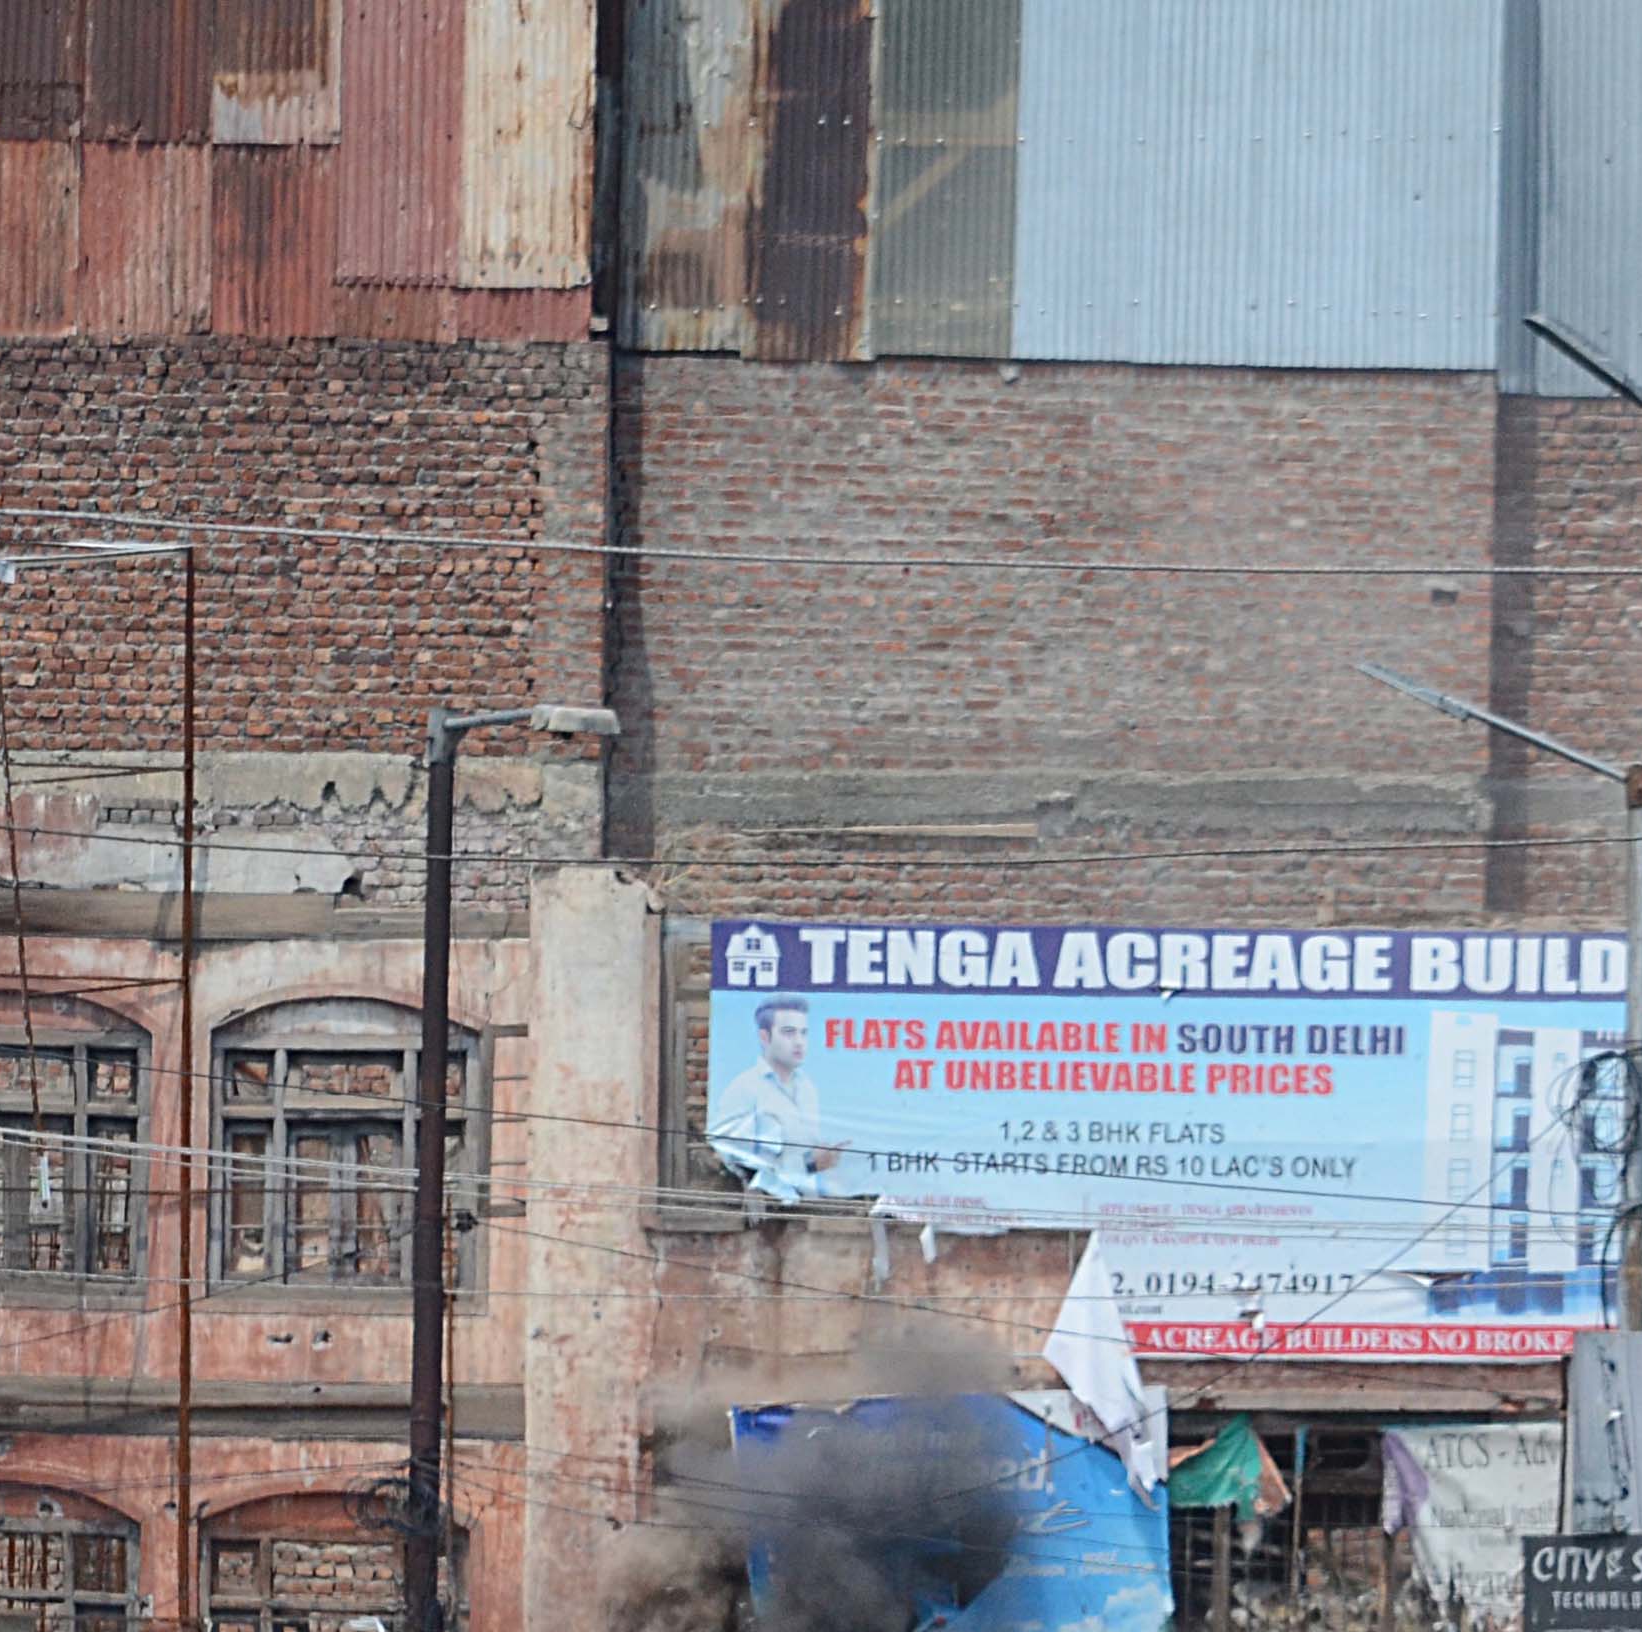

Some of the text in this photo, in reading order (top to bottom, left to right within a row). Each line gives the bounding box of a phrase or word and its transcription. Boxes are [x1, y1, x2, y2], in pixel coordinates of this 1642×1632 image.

[800, 929, 1041, 988] TENGA
[1053, 931, 1394, 993] ACREAGE
[825, 1018, 1407, 1056] FLATS AVAILABLE IN SOUTH DELHI
[894, 1059, 1334, 1096] AT UNBELIEVABLE PRICES
[1043, 1121, 1058, 1143] &
[1065, 1121, 1080, 1143] 3
[1088, 1121, 1140, 1144] BHK
[1149, 1122, 1226, 1145] FLATS
[886, 1152, 940, 1173] BHK
[953, 1151, 1049, 1174] STARTS
[1056, 1153, 1129, 1175] FROM
[1136, 1153, 1168, 1176] RS
[1177, 1156, 1205, 1177] 10
[1210, 1155, 1285, 1178] LAC'S
[1290, 1156, 1356, 1179] ONLY
[1147, 1328, 1284, 1350] ACREAGE
[1285, 1327, 1423, 1352] BUILDERS
[1427, 1328, 1470, 1352] NO
[1475, 1329, 1573, 1353] BROKE
[1531, 1546, 1604, 1583] CITY
